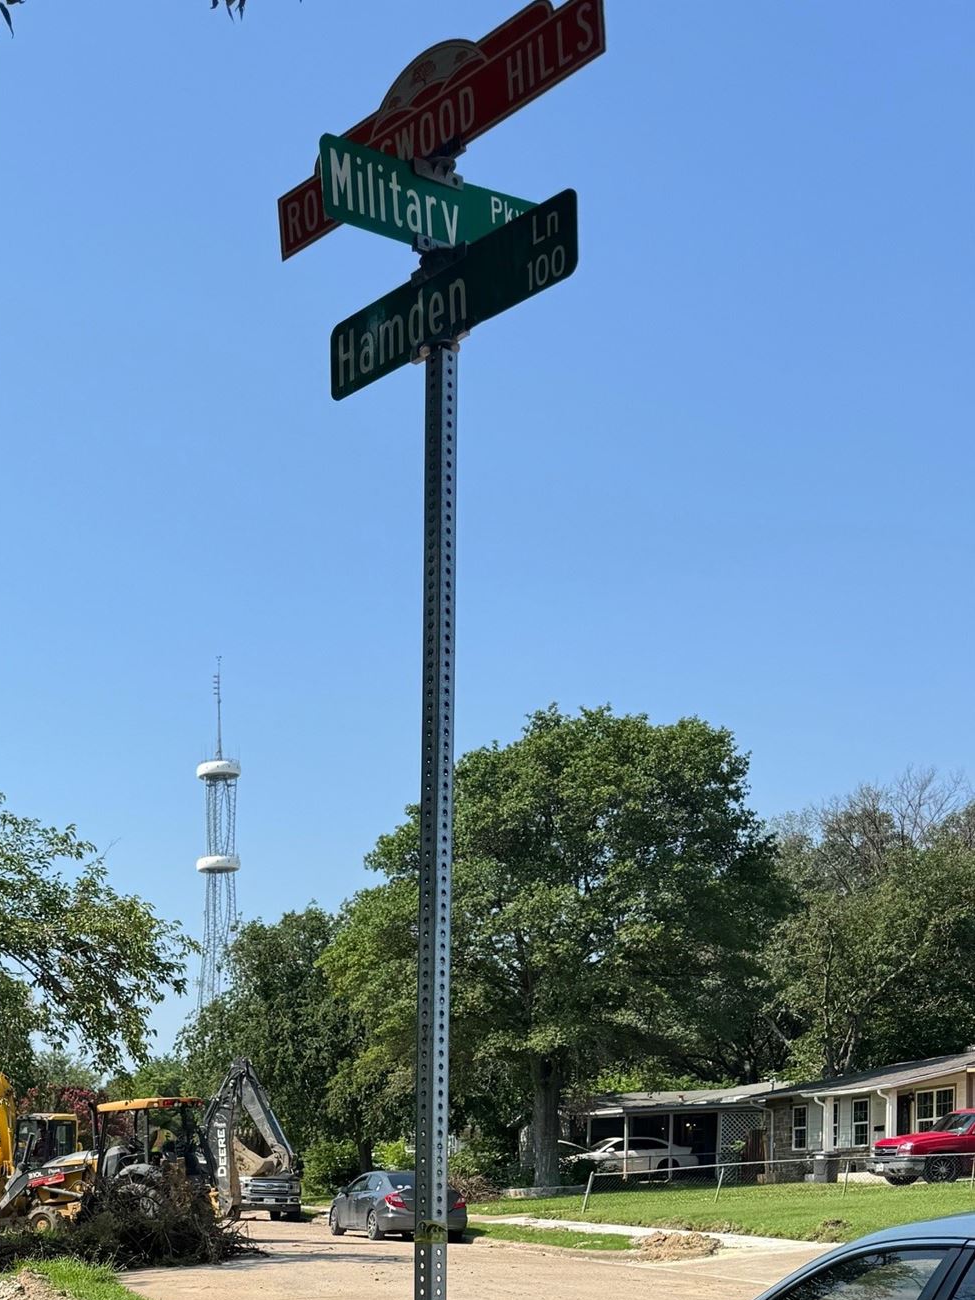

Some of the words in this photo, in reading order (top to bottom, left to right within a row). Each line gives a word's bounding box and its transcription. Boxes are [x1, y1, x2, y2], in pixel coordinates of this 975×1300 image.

[505, 2, 594, 101] HILLS
[329, 148, 458, 247] Military
[490, 195, 525, 225] Pk
[338, 278, 467, 387] Hamden
[532, 210, 559, 246] Ln
[527, 245, 566, 292] 100
[217, 1128, 227, 1178] DEERE
